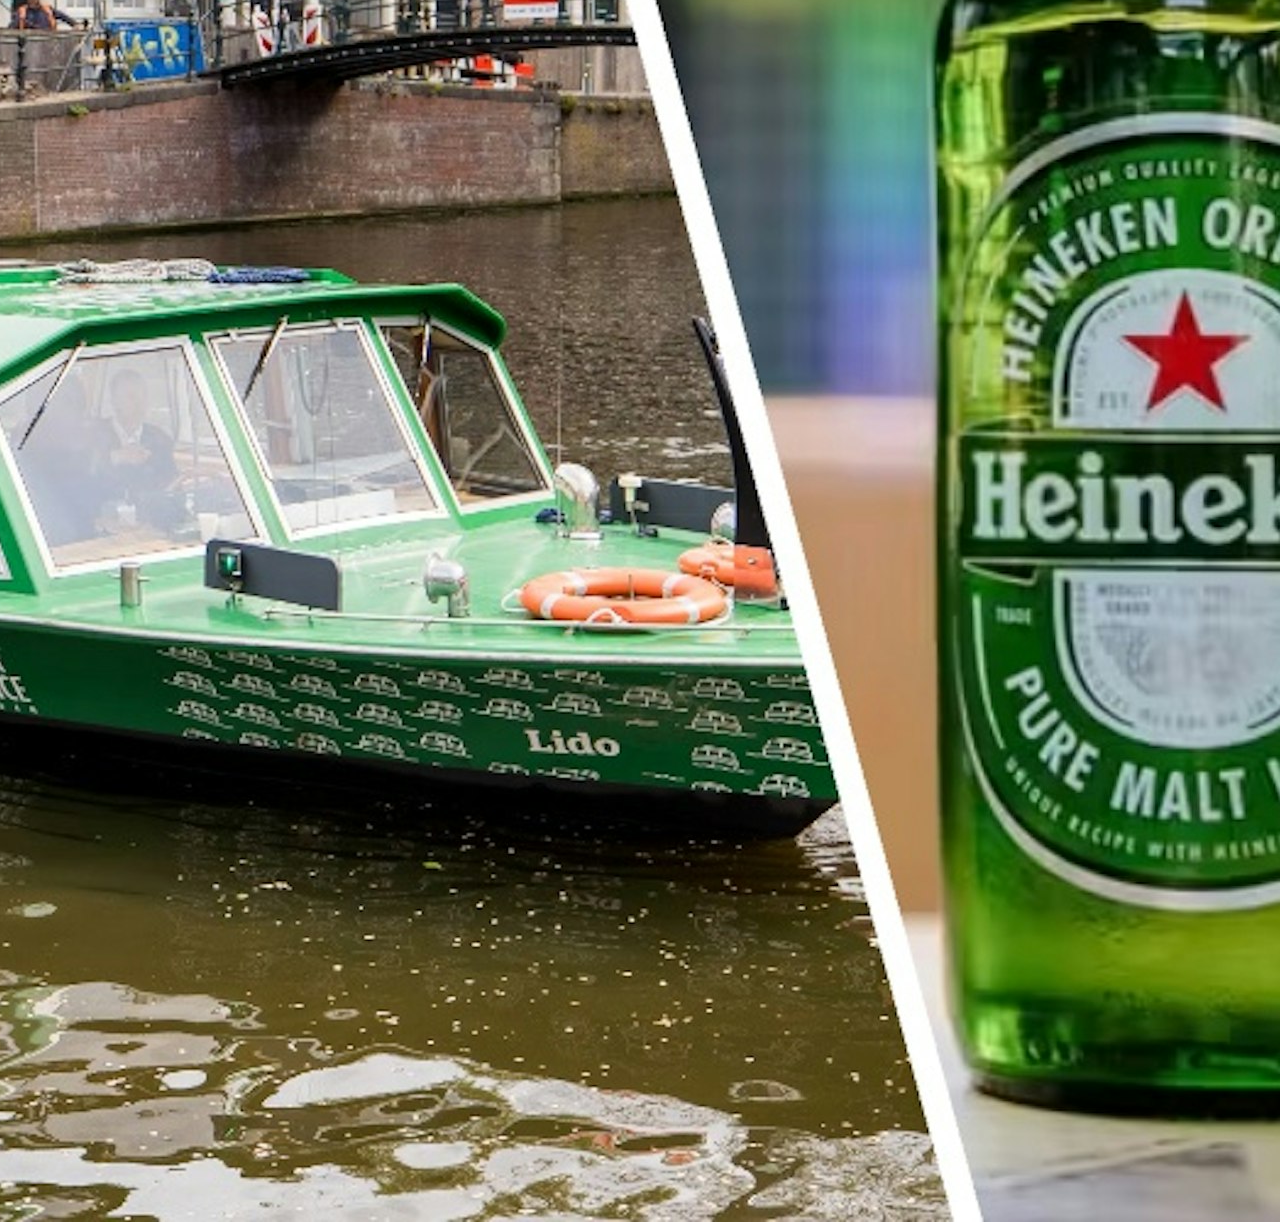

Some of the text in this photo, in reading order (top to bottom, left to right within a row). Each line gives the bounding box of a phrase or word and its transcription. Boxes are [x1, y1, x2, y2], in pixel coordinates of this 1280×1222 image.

[1125, 158, 1217, 179] QUALITY
[1002, 197, 1179, 382] HEINEKEN
[524, 729, 620, 757] Lido
[1004, 665, 1101, 793] PURE
[1110, 761, 1246, 823] MALT
[1006, 755, 1062, 821] UNIQUE
[1068, 813, 1135, 855] RECIPE
[1147, 841, 1201, 861] WITH
